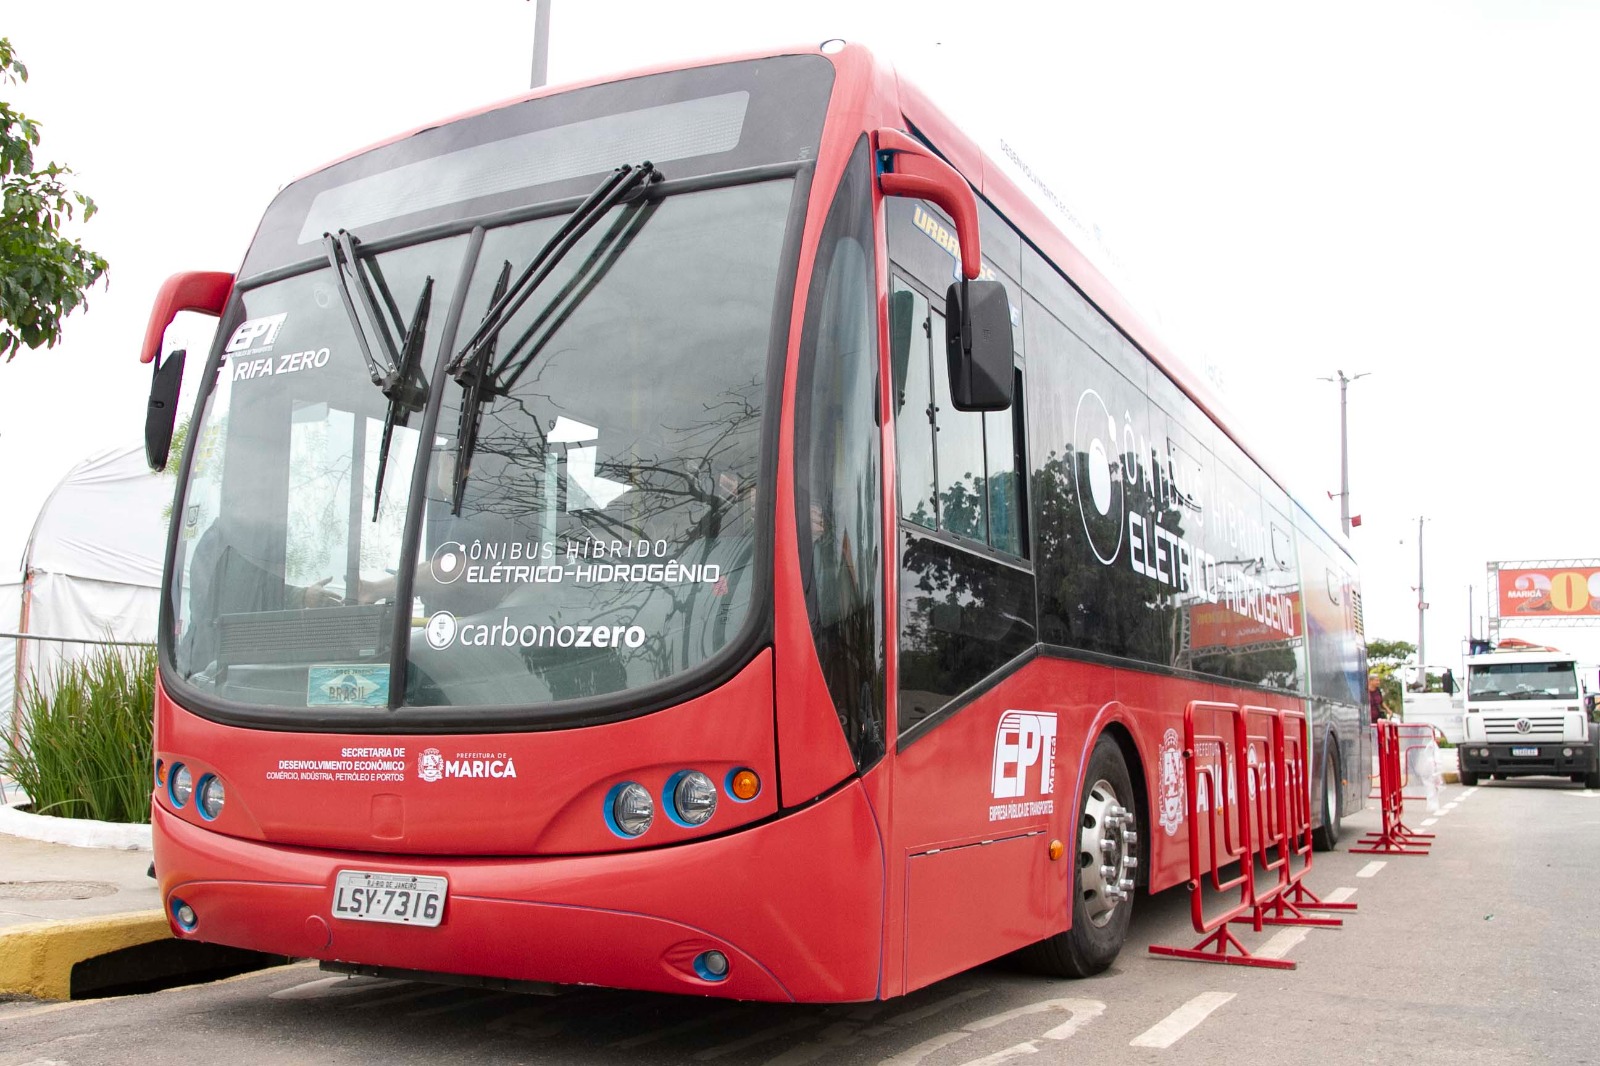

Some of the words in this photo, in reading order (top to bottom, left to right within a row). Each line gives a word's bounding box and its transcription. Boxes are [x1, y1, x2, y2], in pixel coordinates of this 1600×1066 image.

[224, 311, 289, 352] EPT
[275, 347, 330, 374] ZERO
[469, 539, 554, 560] ÔNIBUS
[566, 537, 667, 558] HÍBRIDO
[466, 559, 720, 583] ELÉTRICO-HIDROGÊNIO
[1128, 510, 1294, 637] ELÉTRICO-HIDROGÊNIO
[1507, 588, 1542, 599] MARICÁ
[460, 616, 646, 648] carbonozero
[329, 685, 366, 702] BRASIL
[341, 747, 392, 758] SECRETARIA
[393, 747, 406, 758] DE
[991, 709, 1057, 799] EPT
[278, 760, 353, 771] DESENVOLVIMENTO
[353, 759, 405, 771] ECONÔMICO
[445, 757, 517, 778] MARICÁ
[266, 771, 300, 781] COMÉRCIO,
[300, 771, 335, 782] INDÚSTRIA,
[335, 771, 370, 782] PETRÓLEO
[370, 773, 376, 782] E
[376, 773, 405, 782] PORTOS
[394, 882, 417, 890] JANEIRO
